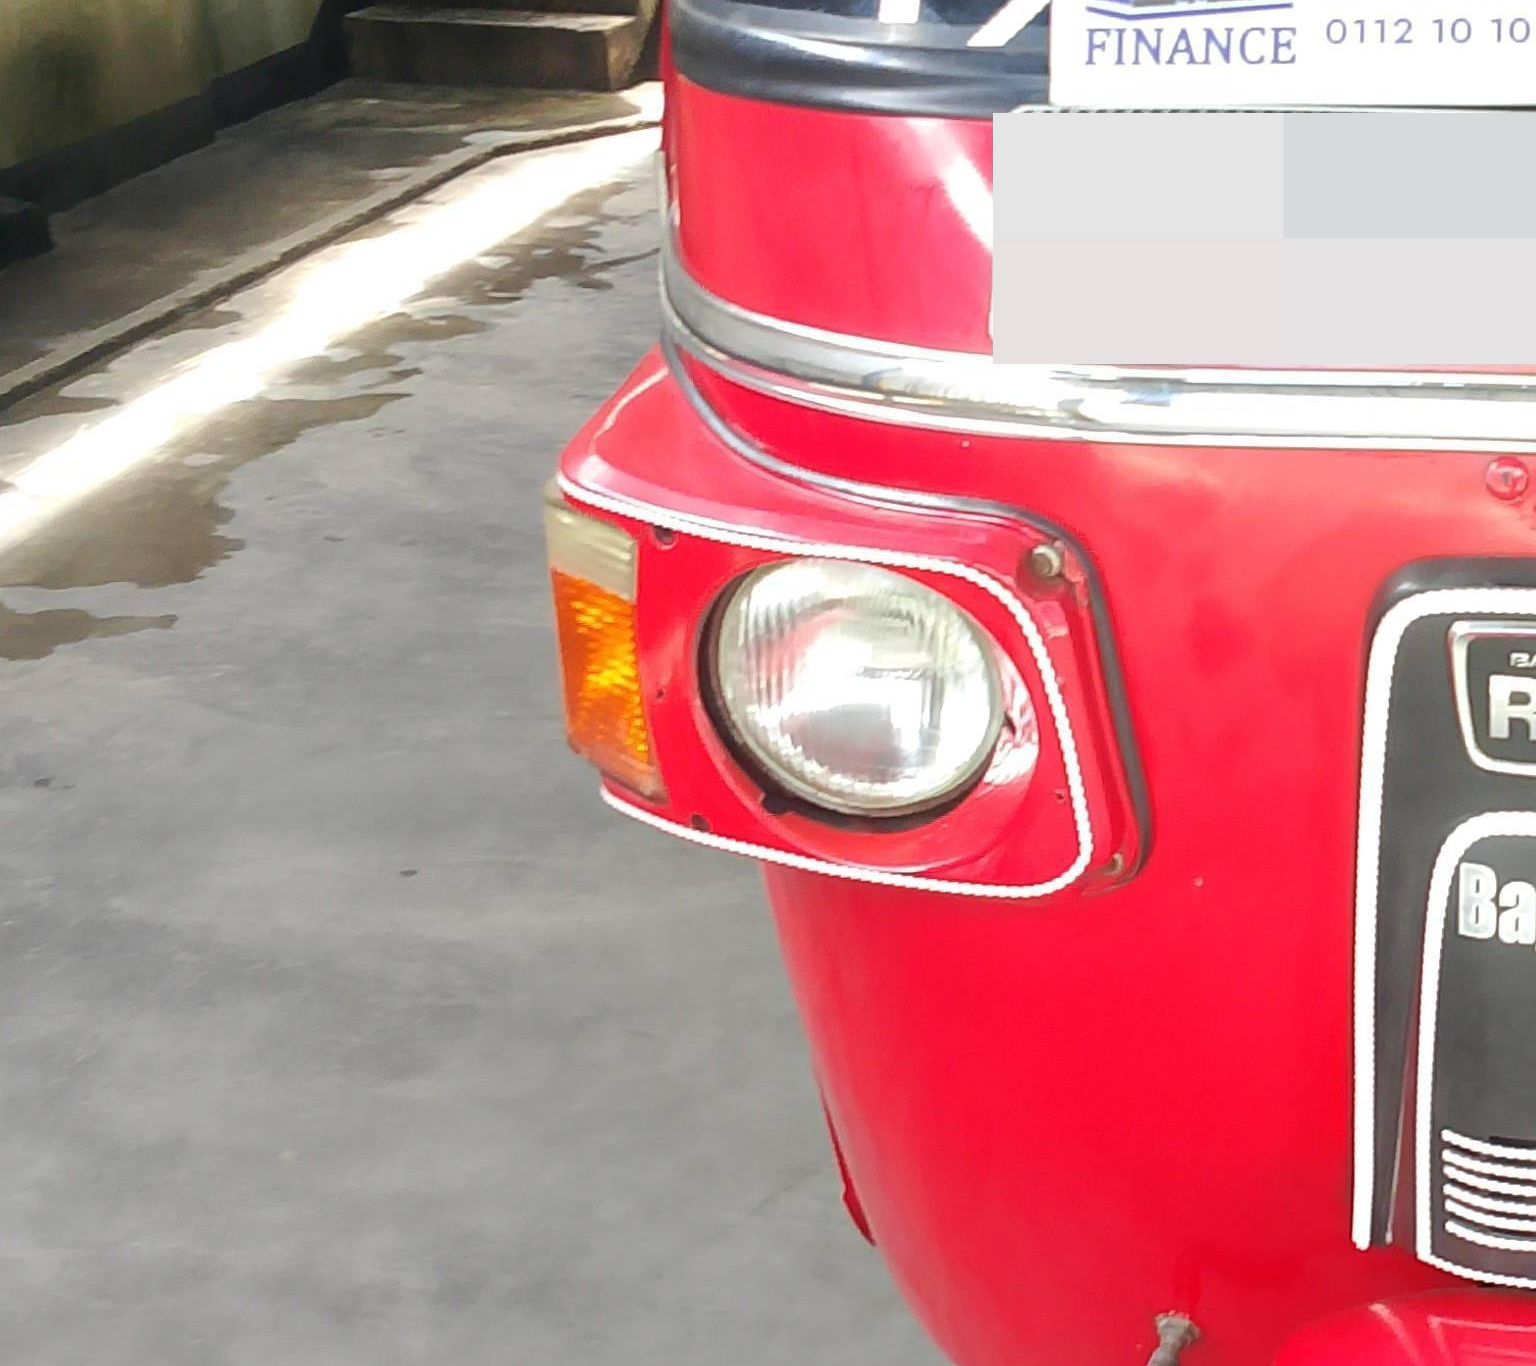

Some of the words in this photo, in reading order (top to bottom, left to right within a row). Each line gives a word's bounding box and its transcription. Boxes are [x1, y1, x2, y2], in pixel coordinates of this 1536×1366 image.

[1085, 26, 1297, 66] FINANCE
[1325, 17, 1414, 45] 0112
[1432, 17, 1473, 44] 10
[1490, 17, 1532, 44] 10
